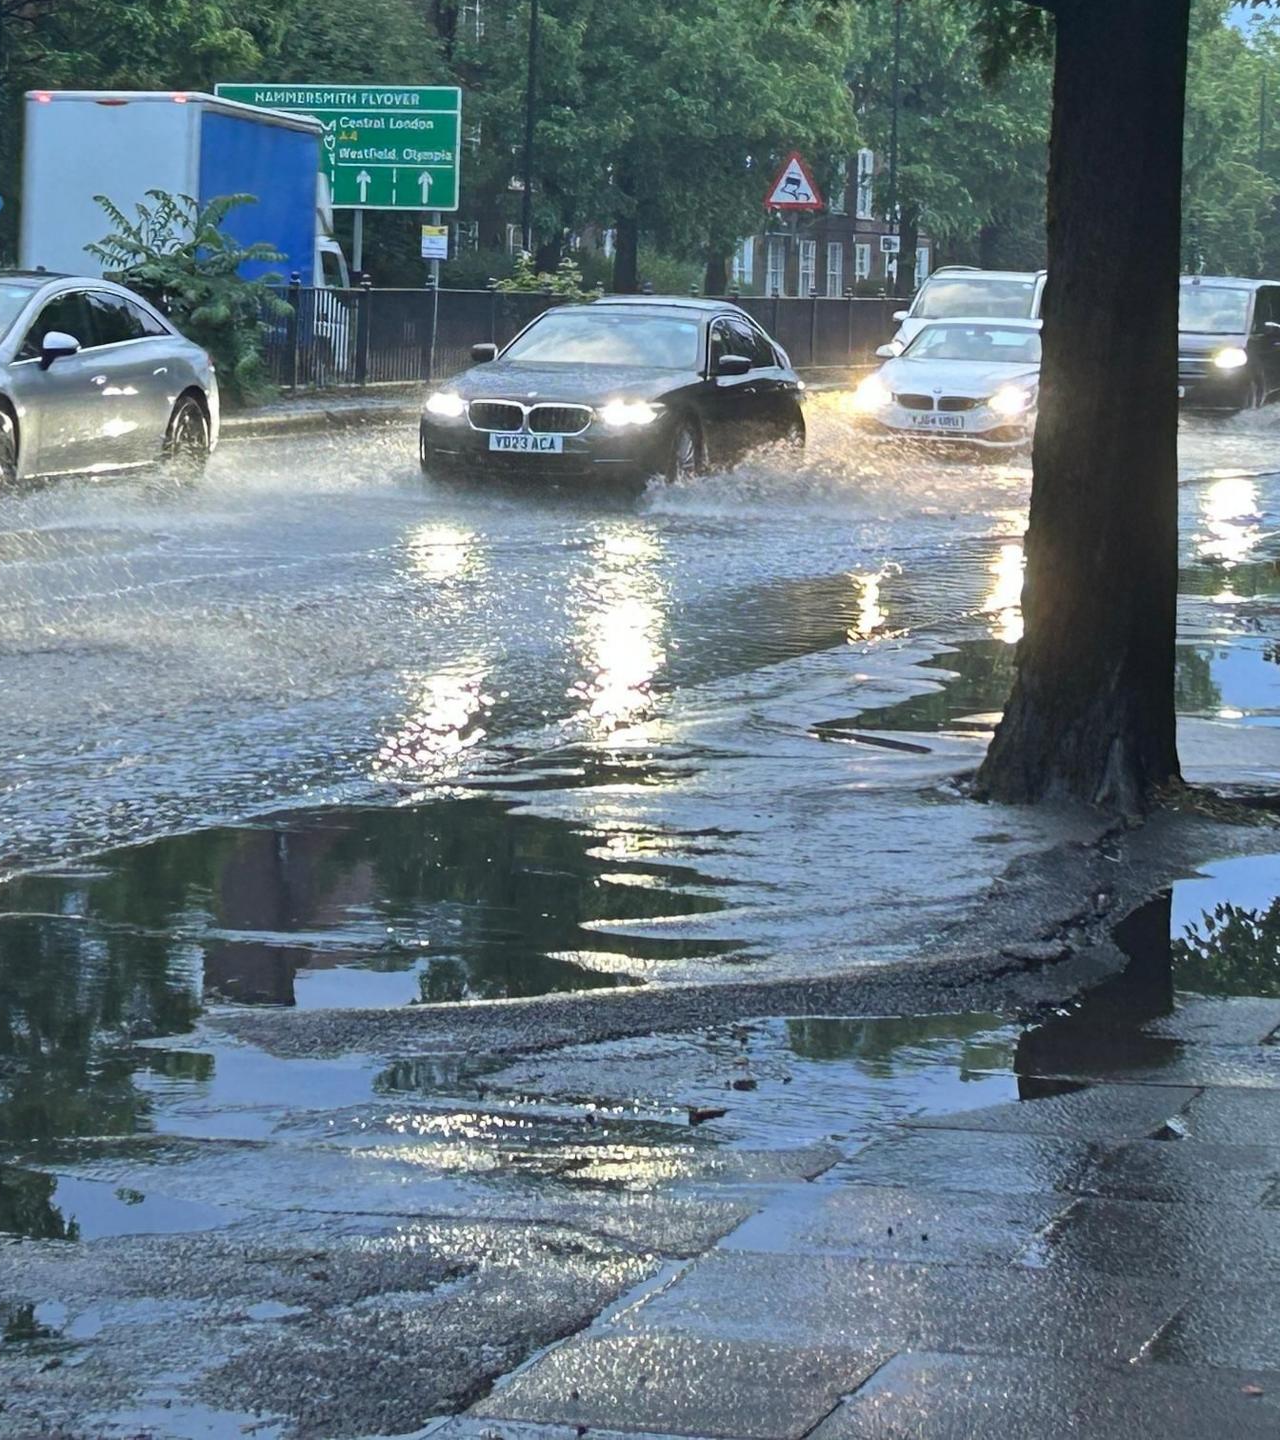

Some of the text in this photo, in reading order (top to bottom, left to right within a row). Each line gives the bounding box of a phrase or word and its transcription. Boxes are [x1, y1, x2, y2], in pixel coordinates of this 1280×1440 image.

[255, 91, 420, 106] HAMMERSMITH FLYOVER
[339, 116, 434, 130] Central London
[402, 148, 453, 162] Olympia
